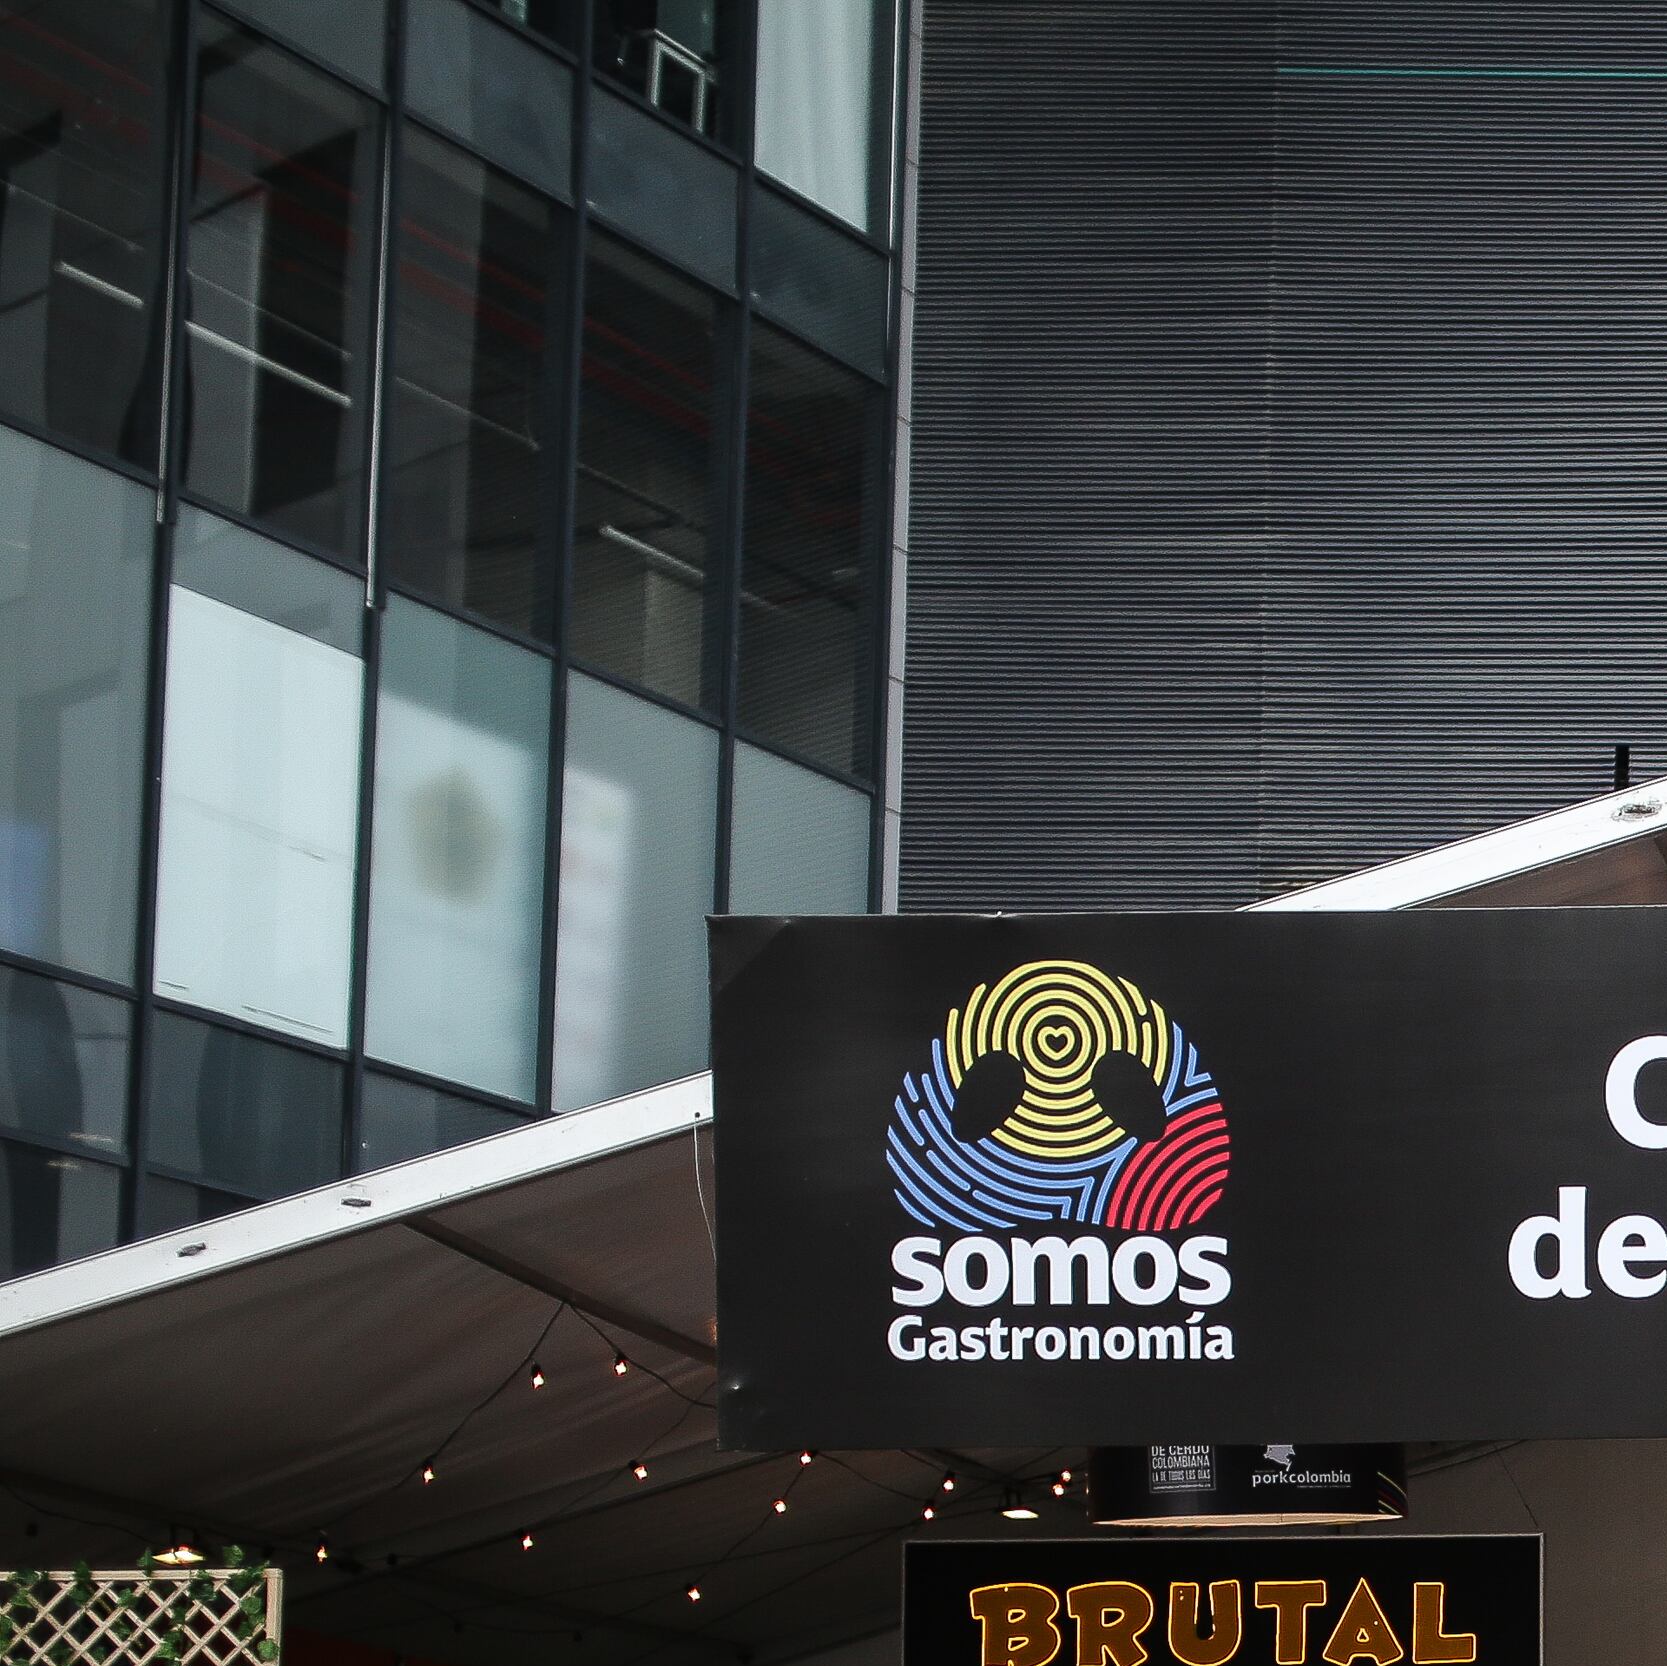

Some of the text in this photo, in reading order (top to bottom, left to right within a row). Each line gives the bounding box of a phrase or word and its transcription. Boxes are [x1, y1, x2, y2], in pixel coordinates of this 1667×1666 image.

[891, 1235, 1232, 1306] somos
[887, 1313, 1234, 1360] Gastronomía
[1152, 1456, 1210, 1469] COLOMBIANA
[1252, 1470, 1351, 1487] porkcolombia
